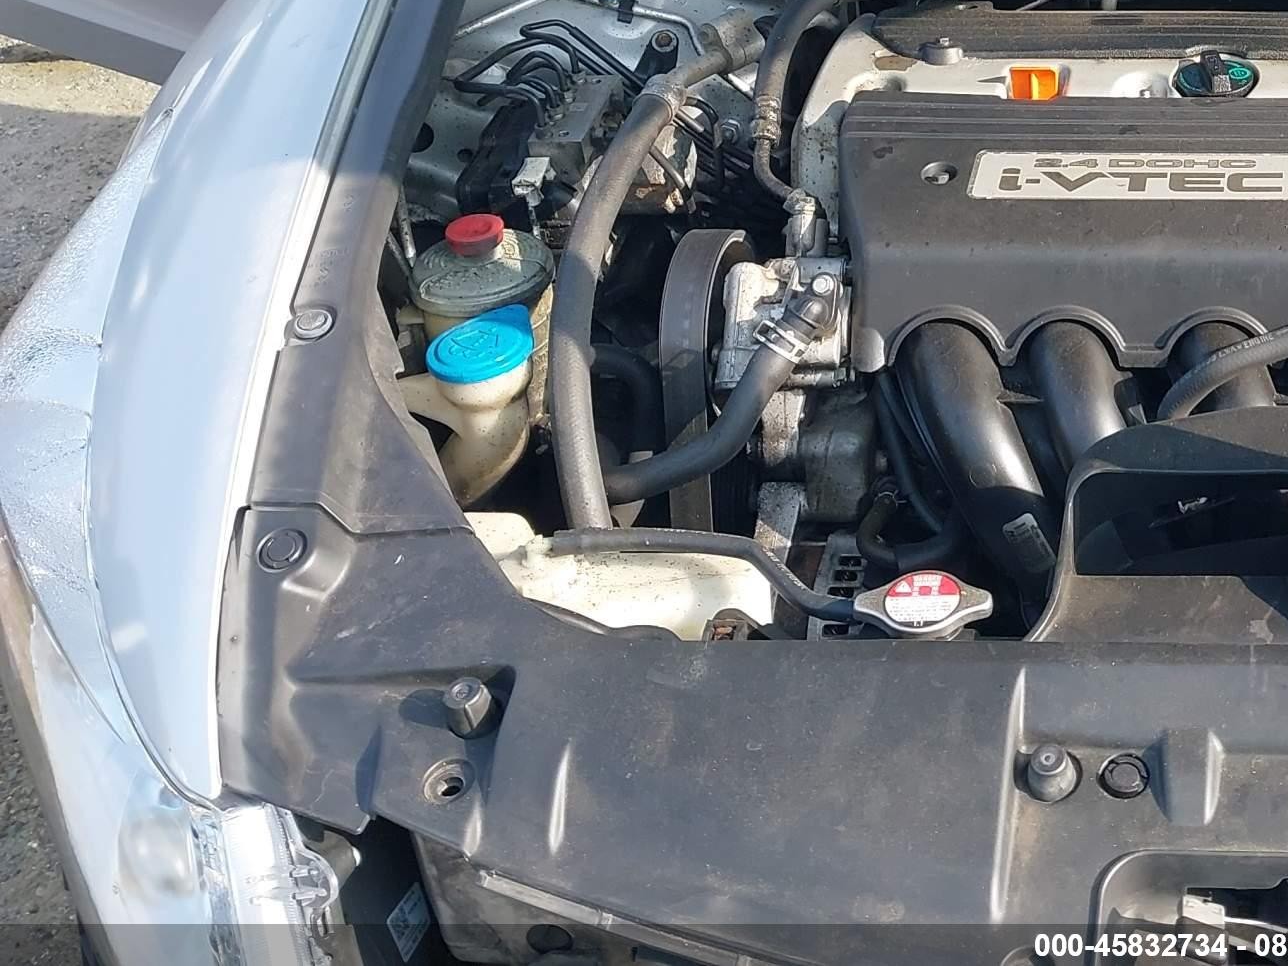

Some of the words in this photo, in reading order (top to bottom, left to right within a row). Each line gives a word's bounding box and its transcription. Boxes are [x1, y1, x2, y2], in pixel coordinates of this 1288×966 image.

[1034, 158, 1098, 168] 2.4
[1109, 158, 1257, 168] DOHC
[998, 167, 1283, 192] i-VTEC
